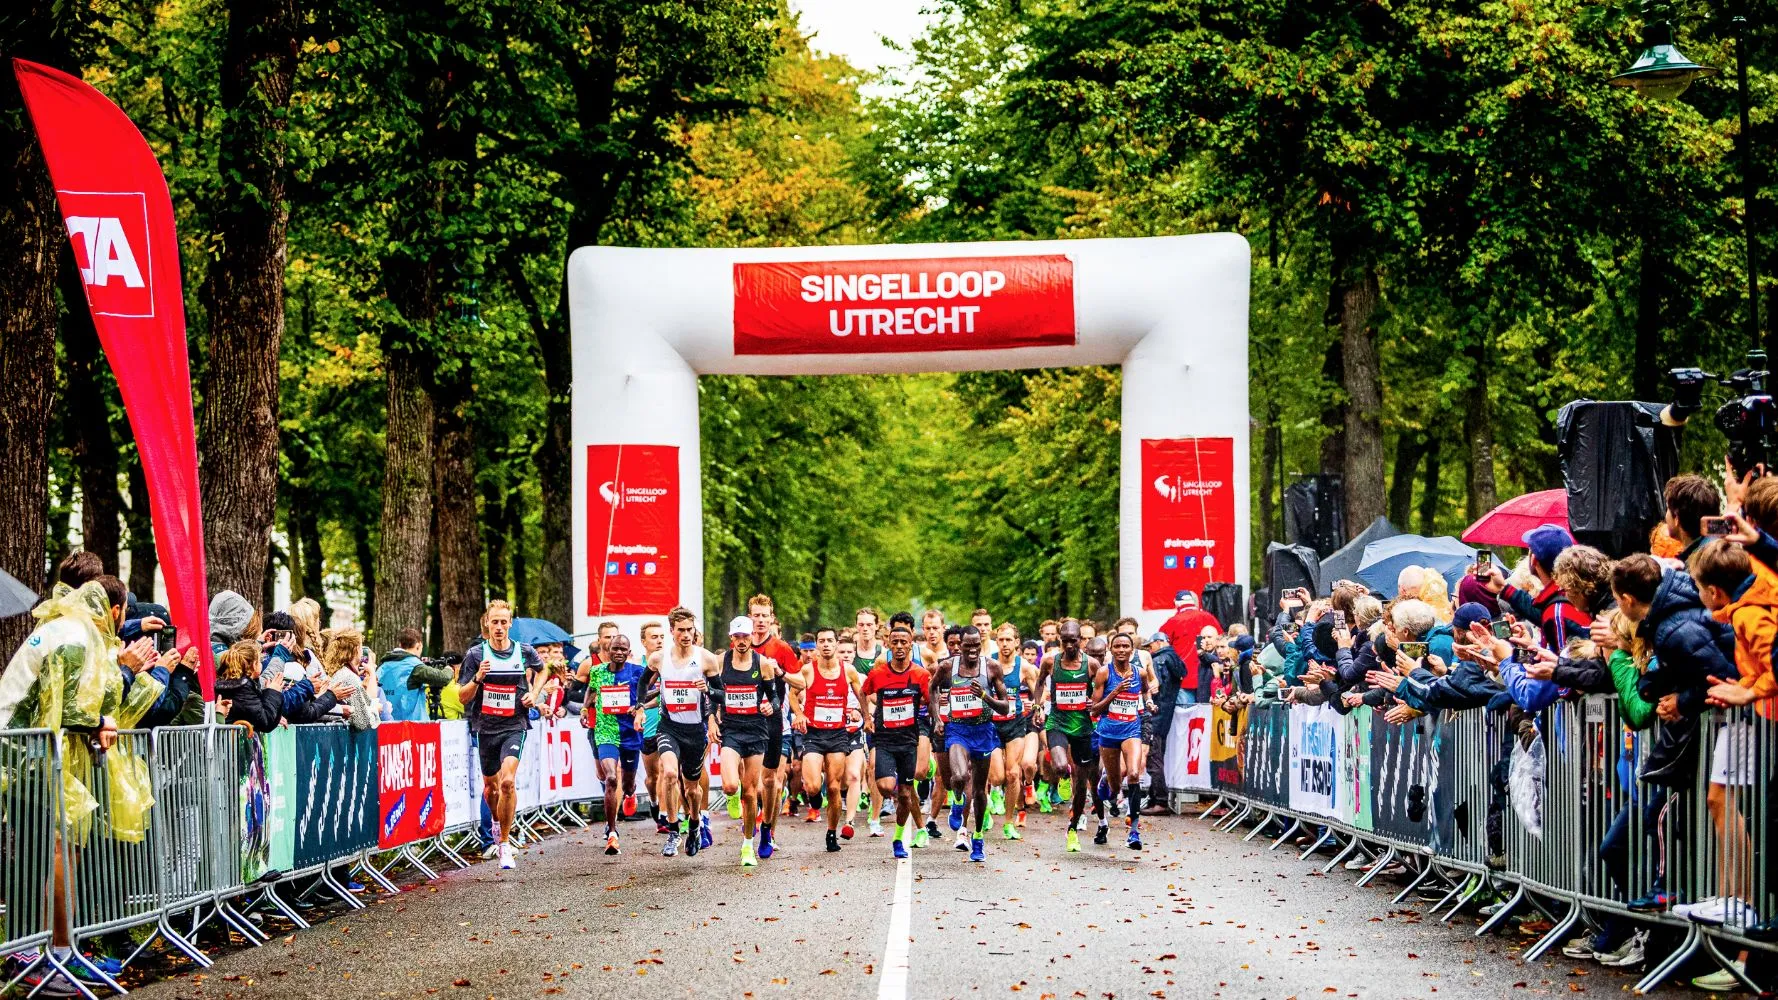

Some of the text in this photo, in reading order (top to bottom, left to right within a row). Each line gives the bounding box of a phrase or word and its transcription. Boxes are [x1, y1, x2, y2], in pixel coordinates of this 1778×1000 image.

[801, 271, 1005, 302] SINGELLOOP
[829, 306, 980, 336] UTRECHT
[1183, 480, 1222, 488] SINGELLOOP
[626, 487, 667, 495] SINGELLOOP
[1183, 488, 1212, 496] UTRECHT
[1164, 538, 1215, 548] #singelloop
[608, 544, 657, 555] #singelloop
[488, 692, 511, 701] DOUMA
[672, 689, 689, 697] PACE
